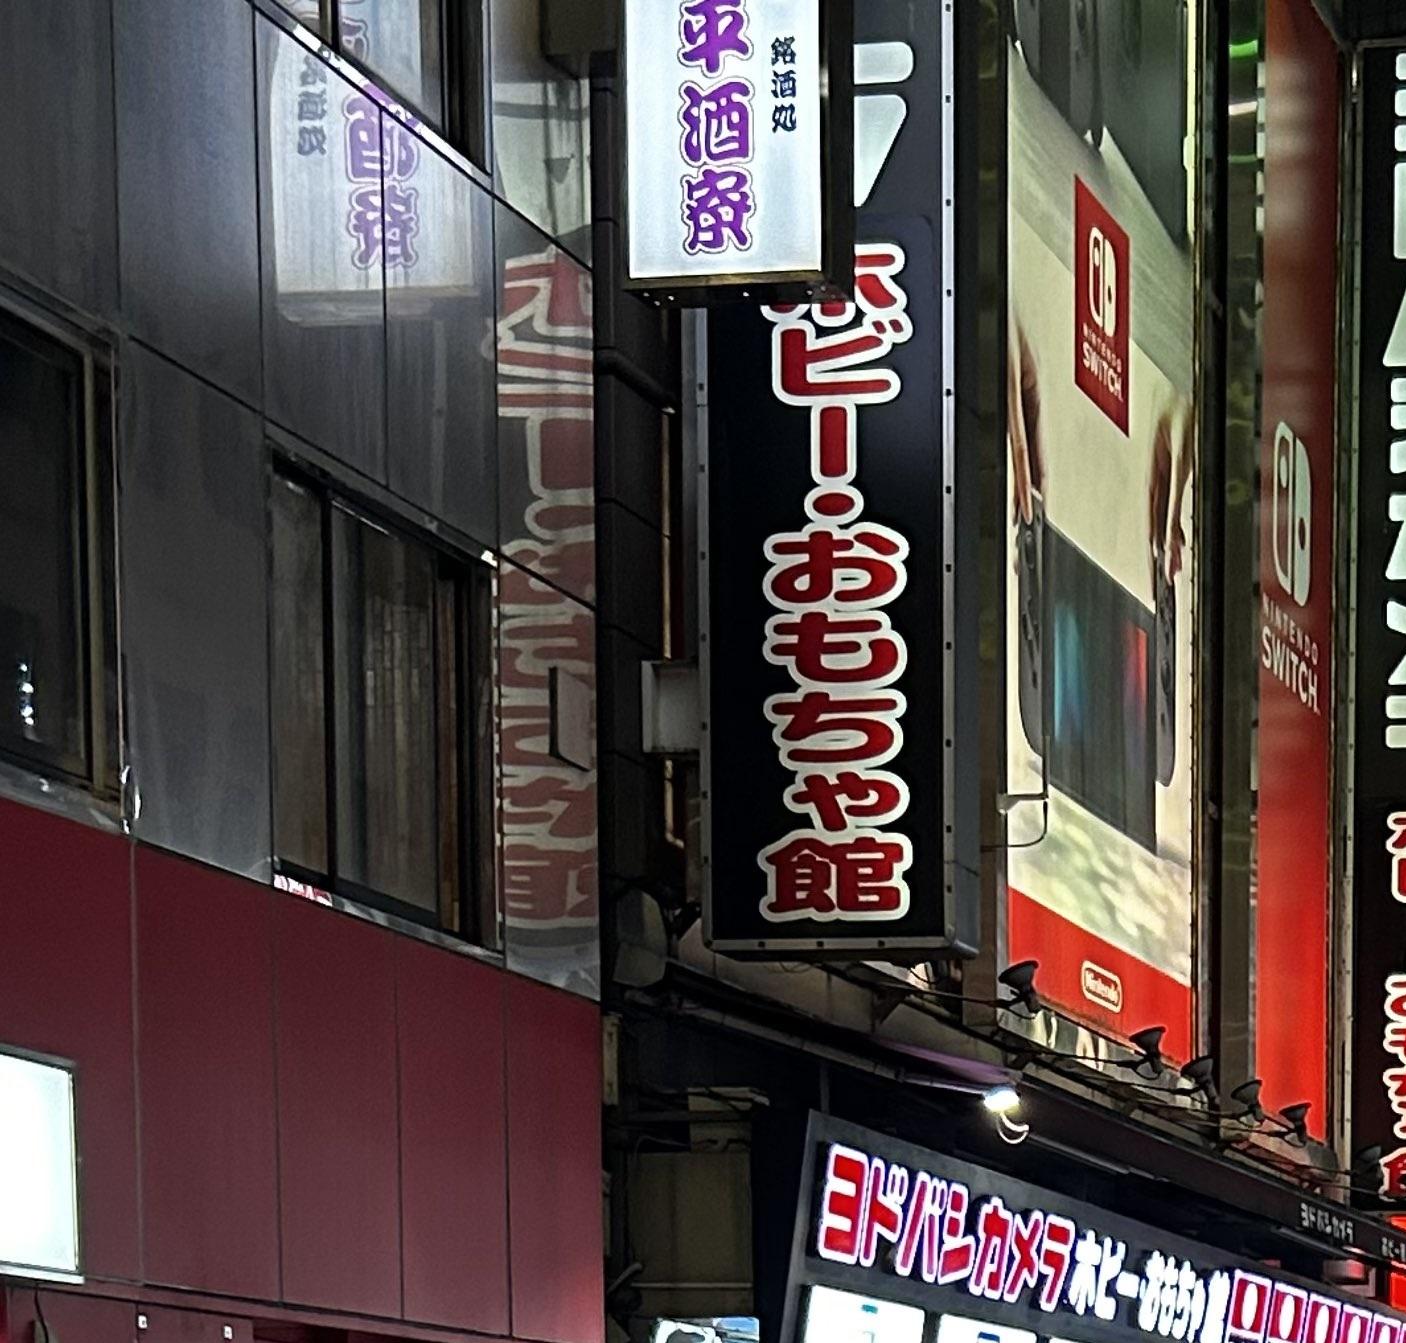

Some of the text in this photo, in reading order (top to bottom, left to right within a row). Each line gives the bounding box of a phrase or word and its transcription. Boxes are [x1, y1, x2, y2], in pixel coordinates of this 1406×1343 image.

[770, 36, 797, 134] 銘酒処
[1083, 343, 1122, 399] SWITCH
[1261, 625, 1319, 713] SWITCH
[1262, 592, 1319, 666] NINTENDO
[817, 1142, 1077, 1313] ヨドバシカメラ
